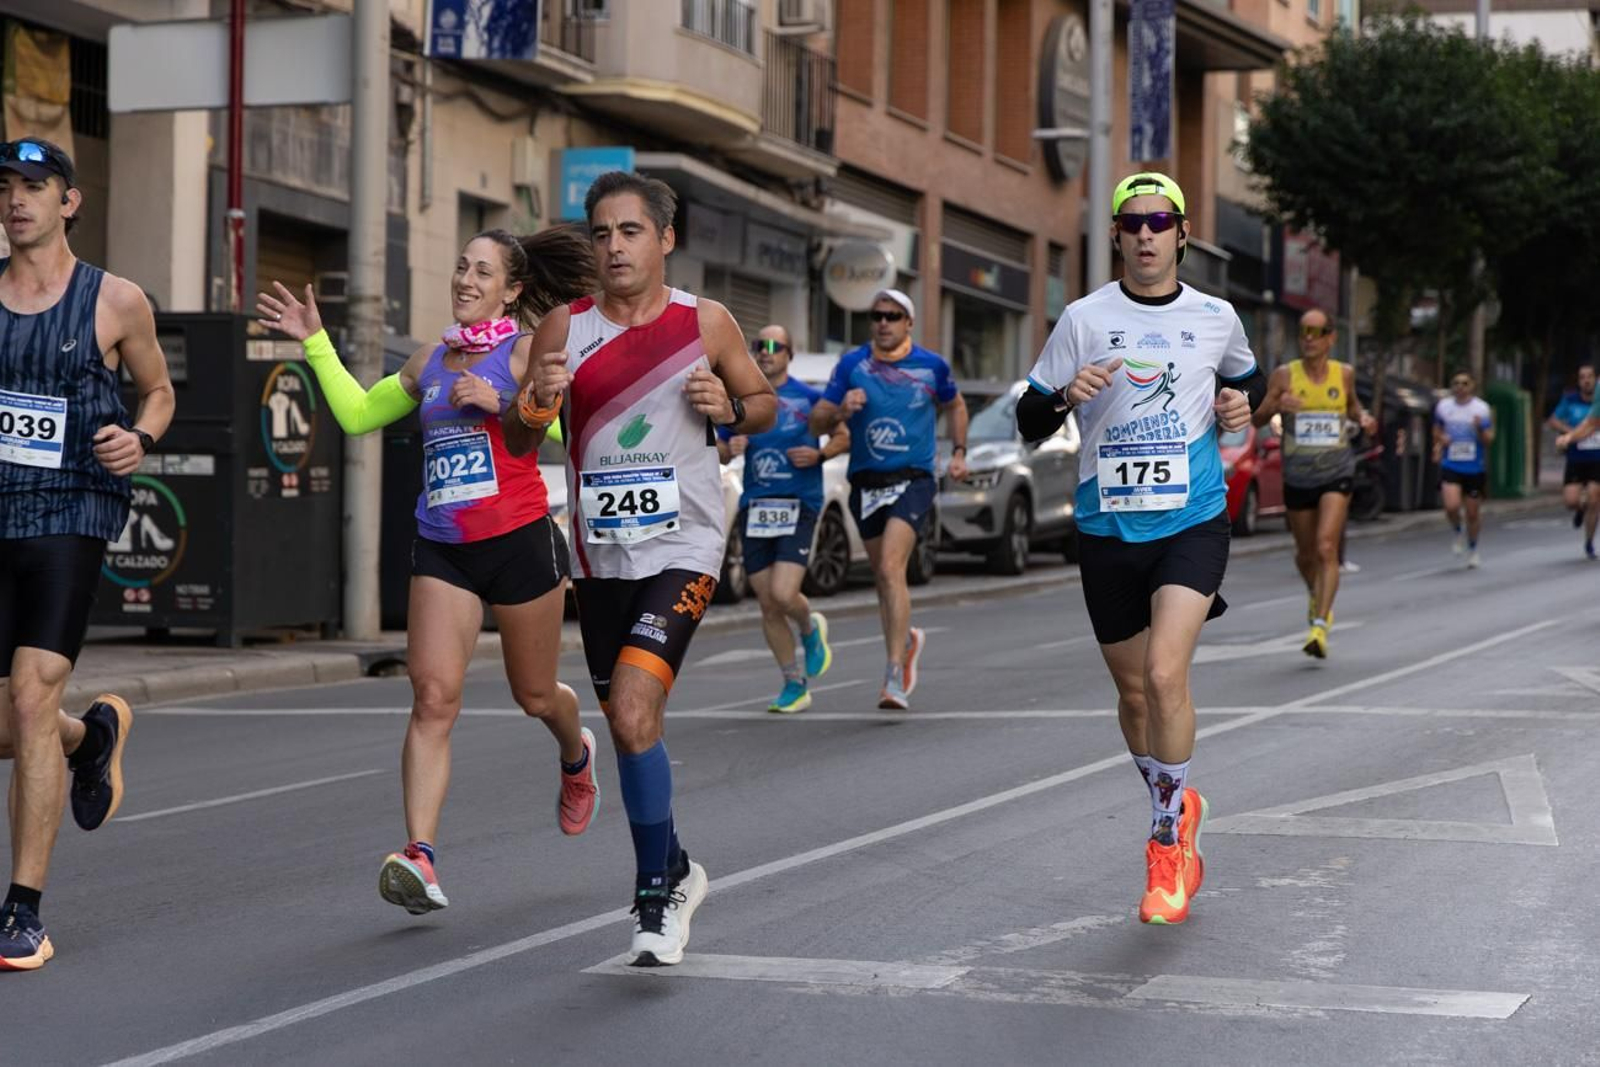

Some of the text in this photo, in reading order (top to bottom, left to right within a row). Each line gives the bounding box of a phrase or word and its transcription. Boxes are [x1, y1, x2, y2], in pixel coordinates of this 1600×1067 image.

[428, 451, 488, 483] 2022
[1115, 461, 1171, 485] 175
[131, 489, 158, 506] OPA
[597, 488, 660, 517] 248
[758, 510, 789, 524] 838
[116, 554, 169, 570] CALZADO
